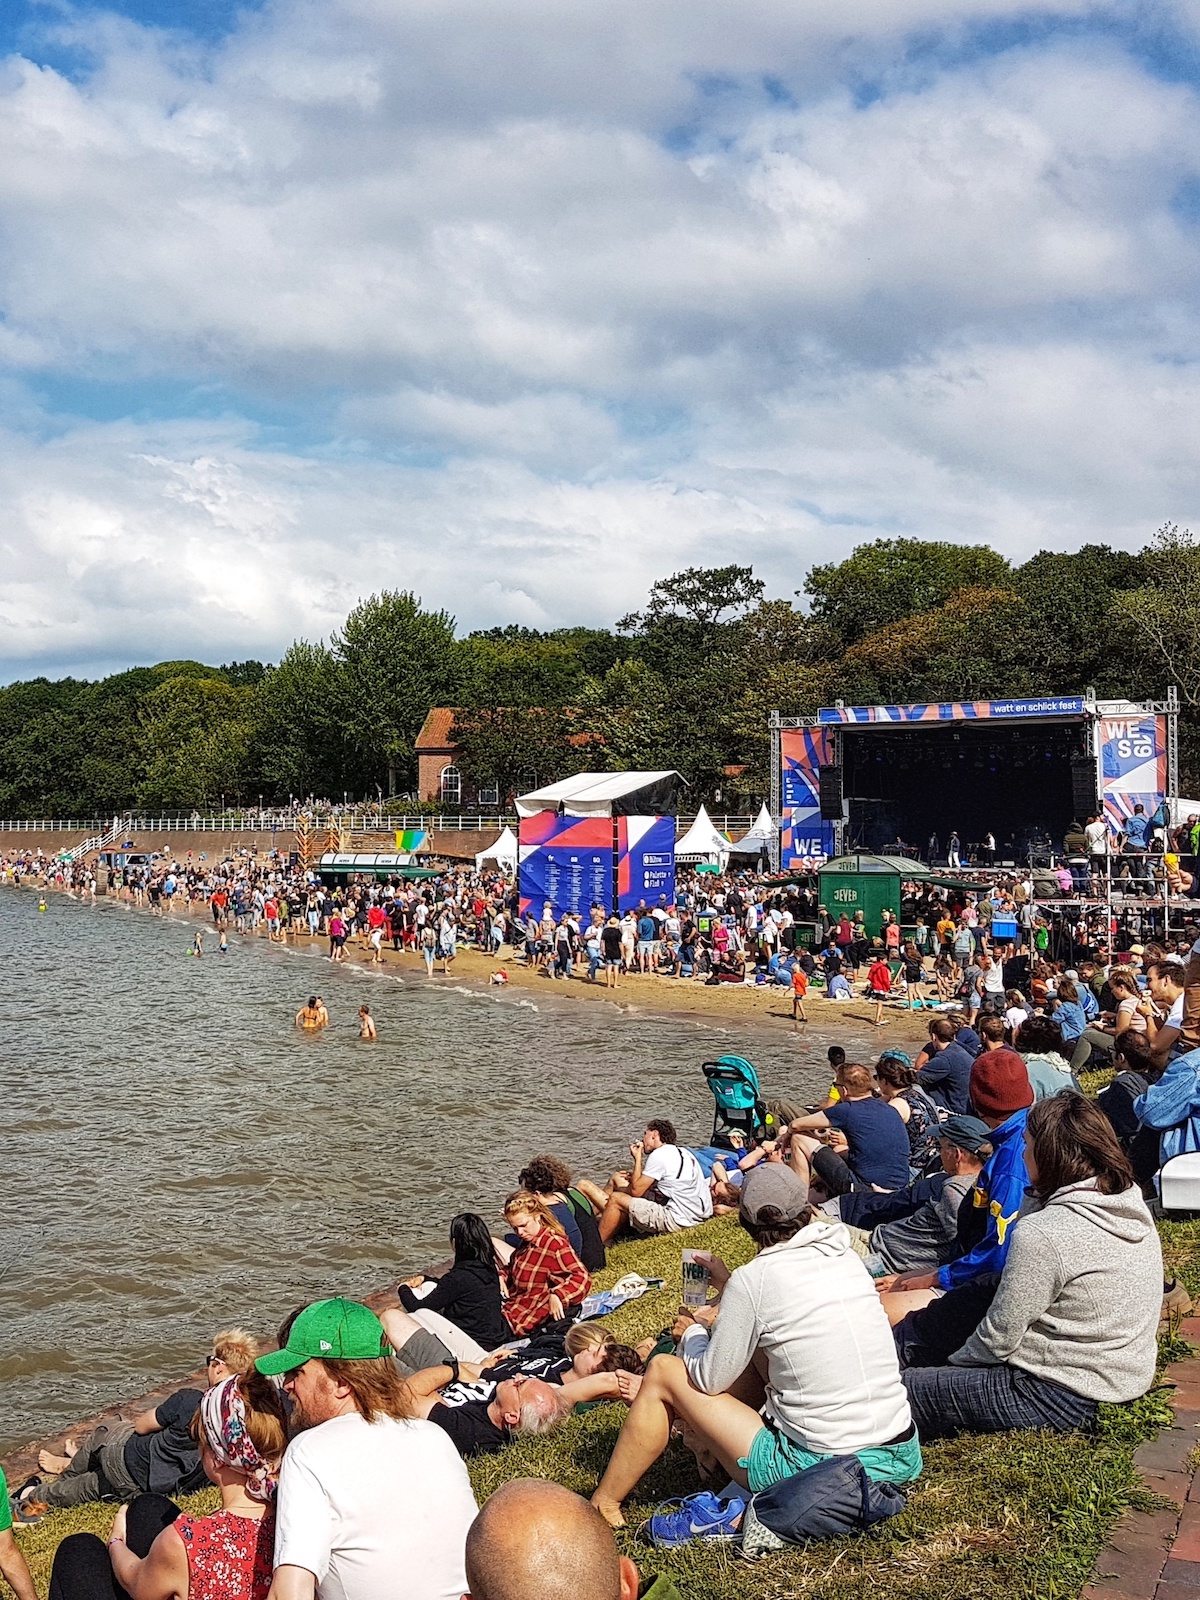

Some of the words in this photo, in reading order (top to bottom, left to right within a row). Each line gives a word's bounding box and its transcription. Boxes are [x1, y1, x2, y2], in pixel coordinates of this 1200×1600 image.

[994, 704, 1014, 713] watt
[1015, 704, 1026, 712] en
[1028, 702, 1057, 711] schlick
[1060, 700, 1077, 710] fest
[1105, 721, 1140, 739] WE
[1118, 739, 1132, 758] S
[794, 838, 822, 855] WE
[838, 861, 857, 871] JEVER
[834, 889, 857, 901] JEVER
